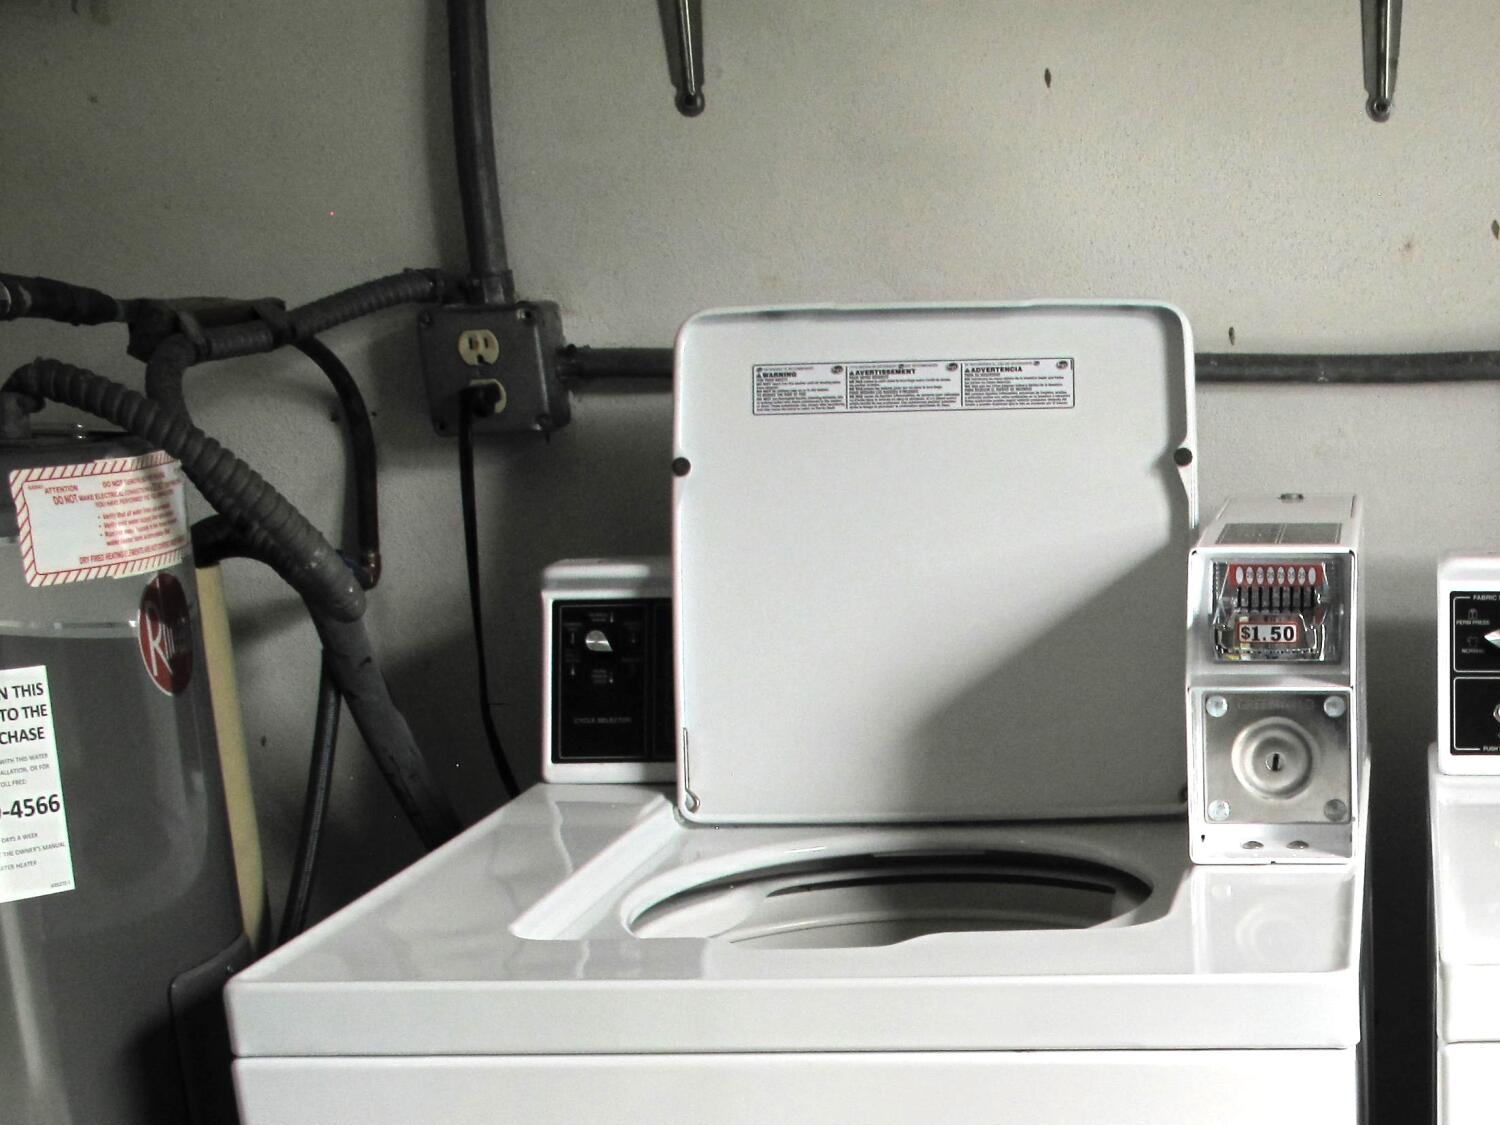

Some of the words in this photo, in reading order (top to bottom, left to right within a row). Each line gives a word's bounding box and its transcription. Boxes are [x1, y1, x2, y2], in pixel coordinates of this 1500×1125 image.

[856, 368, 916, 376] AVERTISSEMENT
[45, 485, 78, 494] ATTENTION
[53, 496, 64, 505] DO
[64, 494, 78, 504] NOT
[1241, 626, 1294, 642] $1.50
[12, 682, 44, 698] THIS
[0, 708, 18, 722] TO
[21, 704, 48, 718] THE
[0, 726, 46, 744] CHASE
[28, 752, 48, 761] WATER
[0, 794, 60, 818] -4566
[23, 832, 38, 840] WEEK
[16, 860, 37, 869] HEATER
